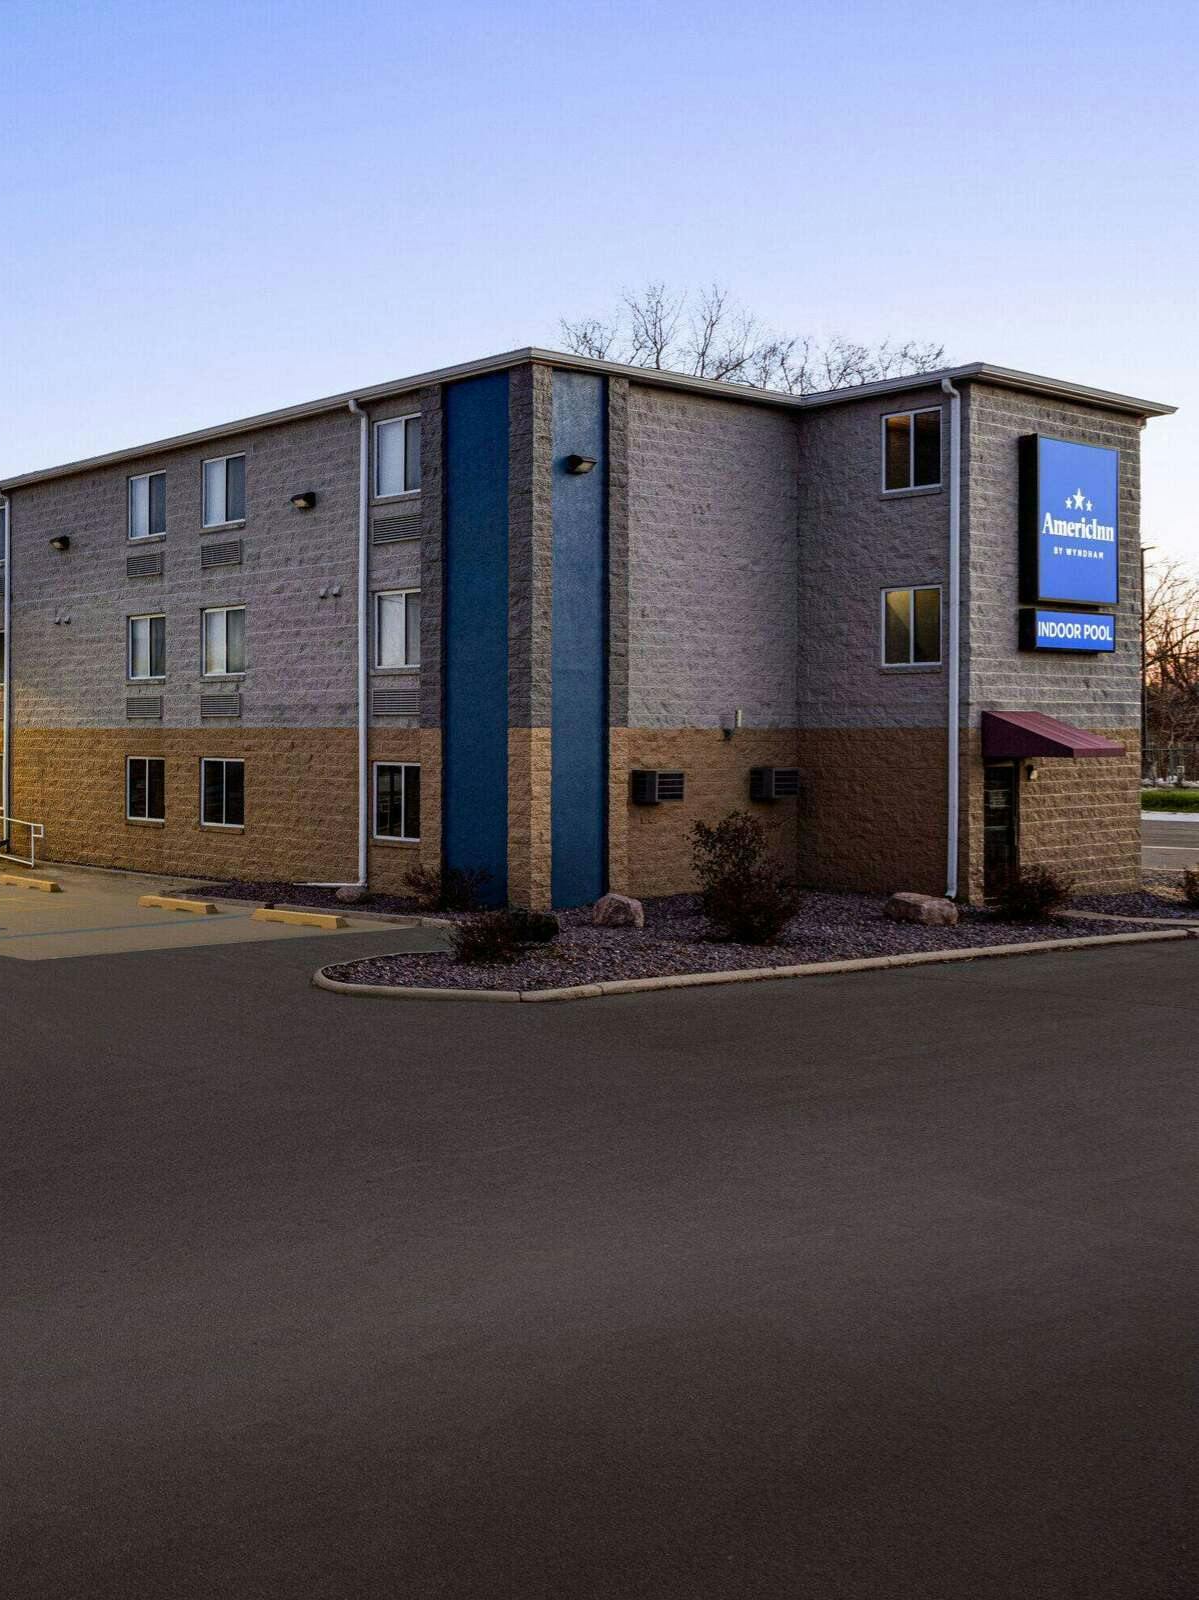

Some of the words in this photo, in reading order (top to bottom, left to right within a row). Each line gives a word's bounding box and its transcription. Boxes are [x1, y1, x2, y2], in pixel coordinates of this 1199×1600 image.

[1042, 512, 1114, 542] AmericInn
[1053, 546, 1063, 555] BY
[1066, 547, 1104, 559] WYNDHAM
[1038, 621, 1081, 640] INDOOR
[1083, 624, 1113, 641] POOL
